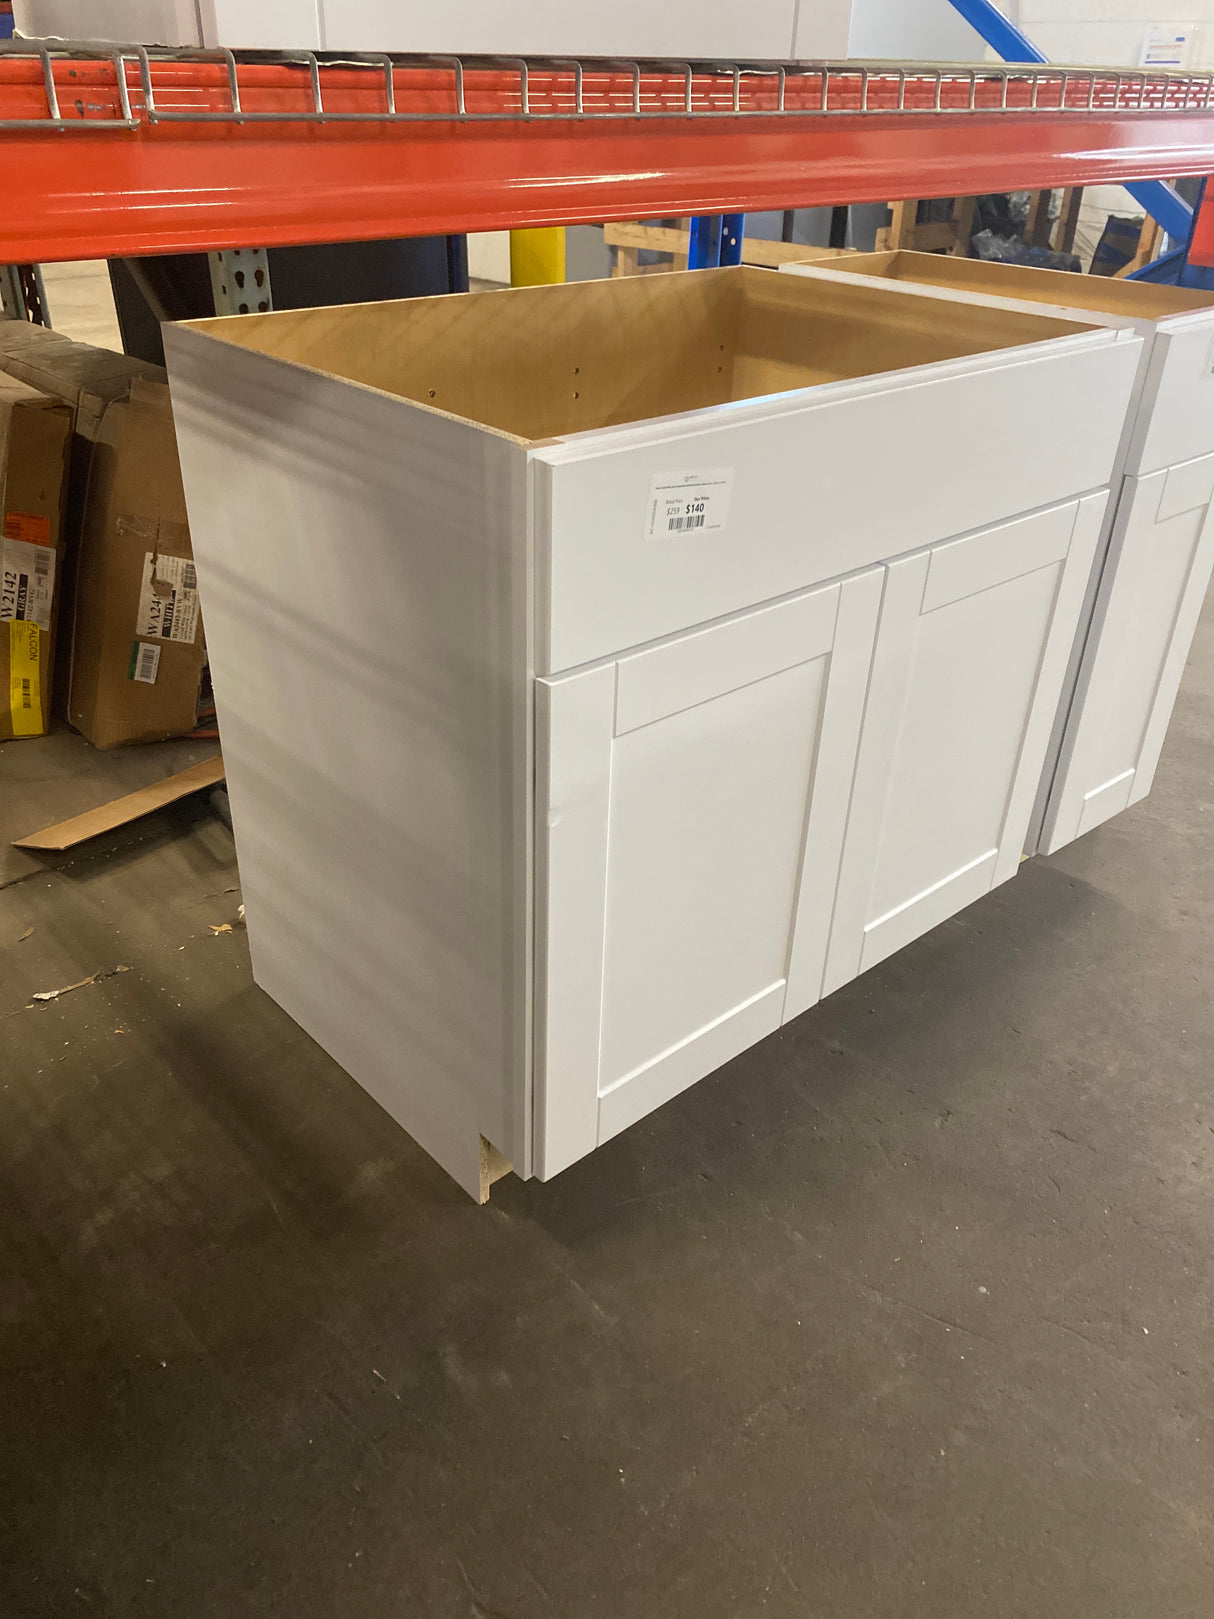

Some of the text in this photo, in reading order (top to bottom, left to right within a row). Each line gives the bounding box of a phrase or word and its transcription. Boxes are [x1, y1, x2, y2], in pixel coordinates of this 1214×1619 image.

[685, 503, 705, 515] $140
[1, 571, 17, 618] W2142
[18, 586, 27, 611] GRAY
[29, 623, 38, 661] FALCON
